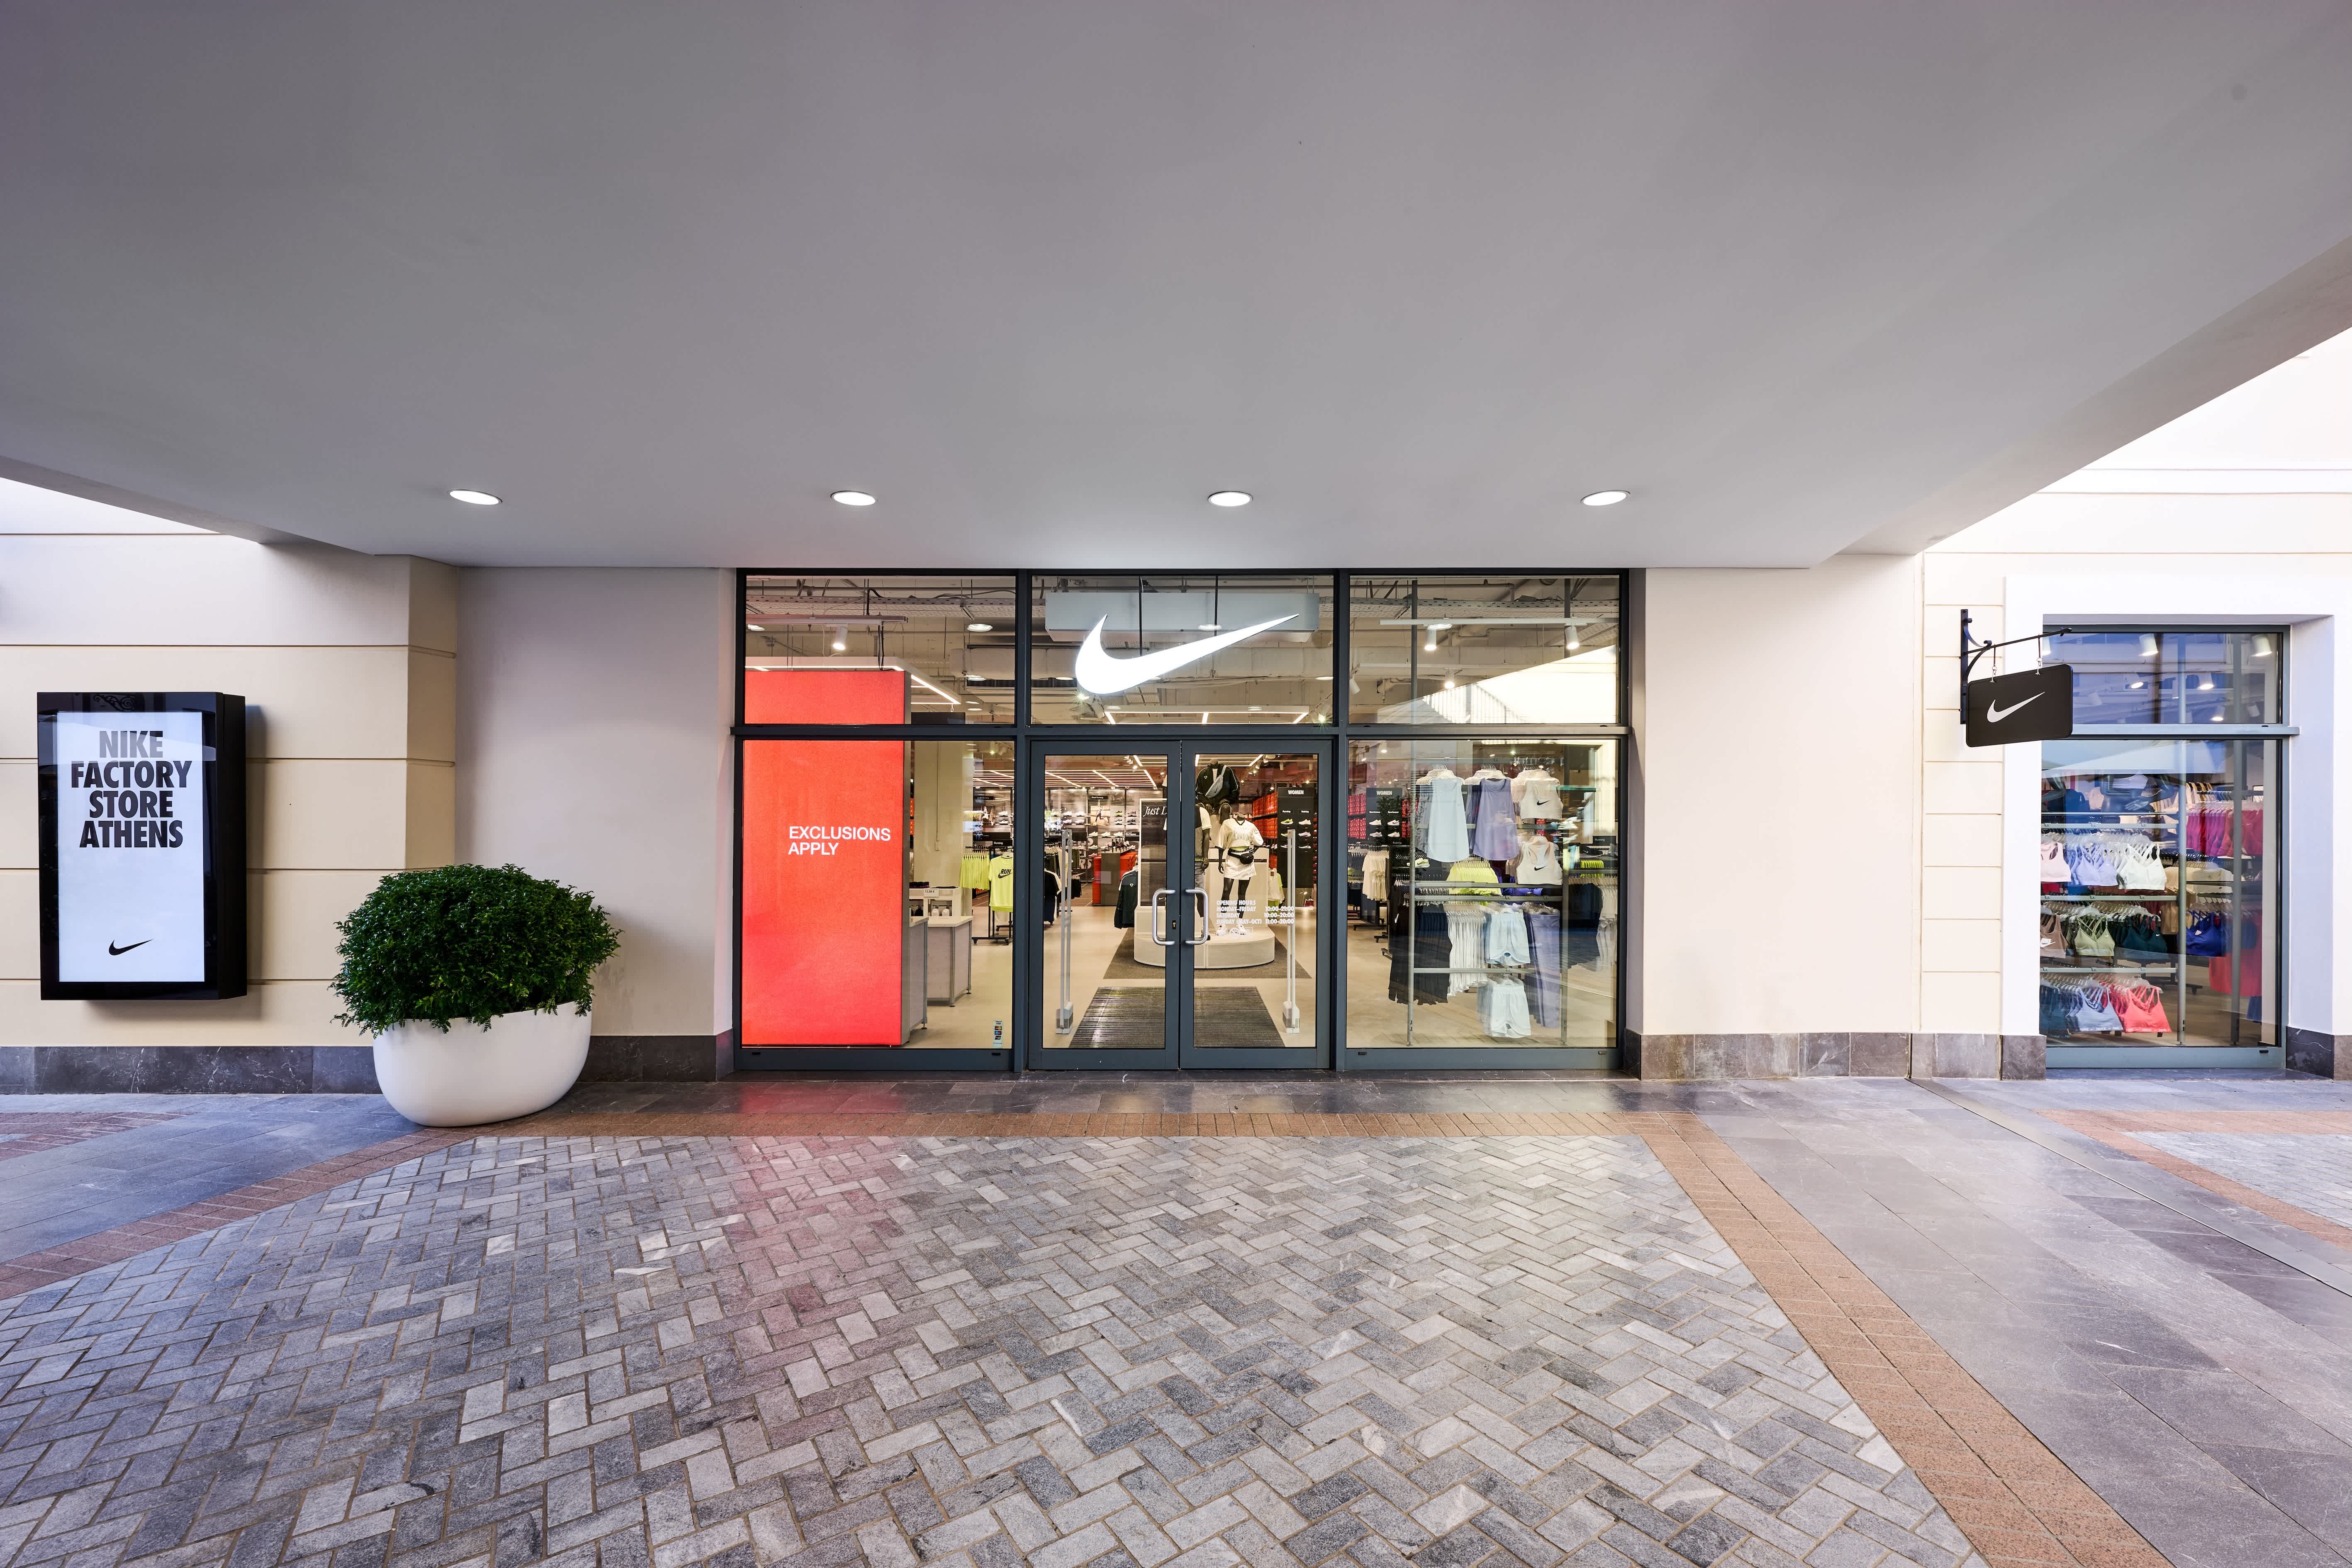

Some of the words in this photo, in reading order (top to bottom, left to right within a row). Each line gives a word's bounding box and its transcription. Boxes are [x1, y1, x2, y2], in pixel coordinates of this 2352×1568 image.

[99, 731, 163, 758] NIKE
[71, 761, 192, 788] FACTORY
[89, 790, 173, 818] STORE
[1142, 806, 1160, 817] Just
[79, 820, 183, 848] ATHENS
[790, 826, 891, 841] EXCLUSIONS
[788, 842, 838, 856] APPLY
